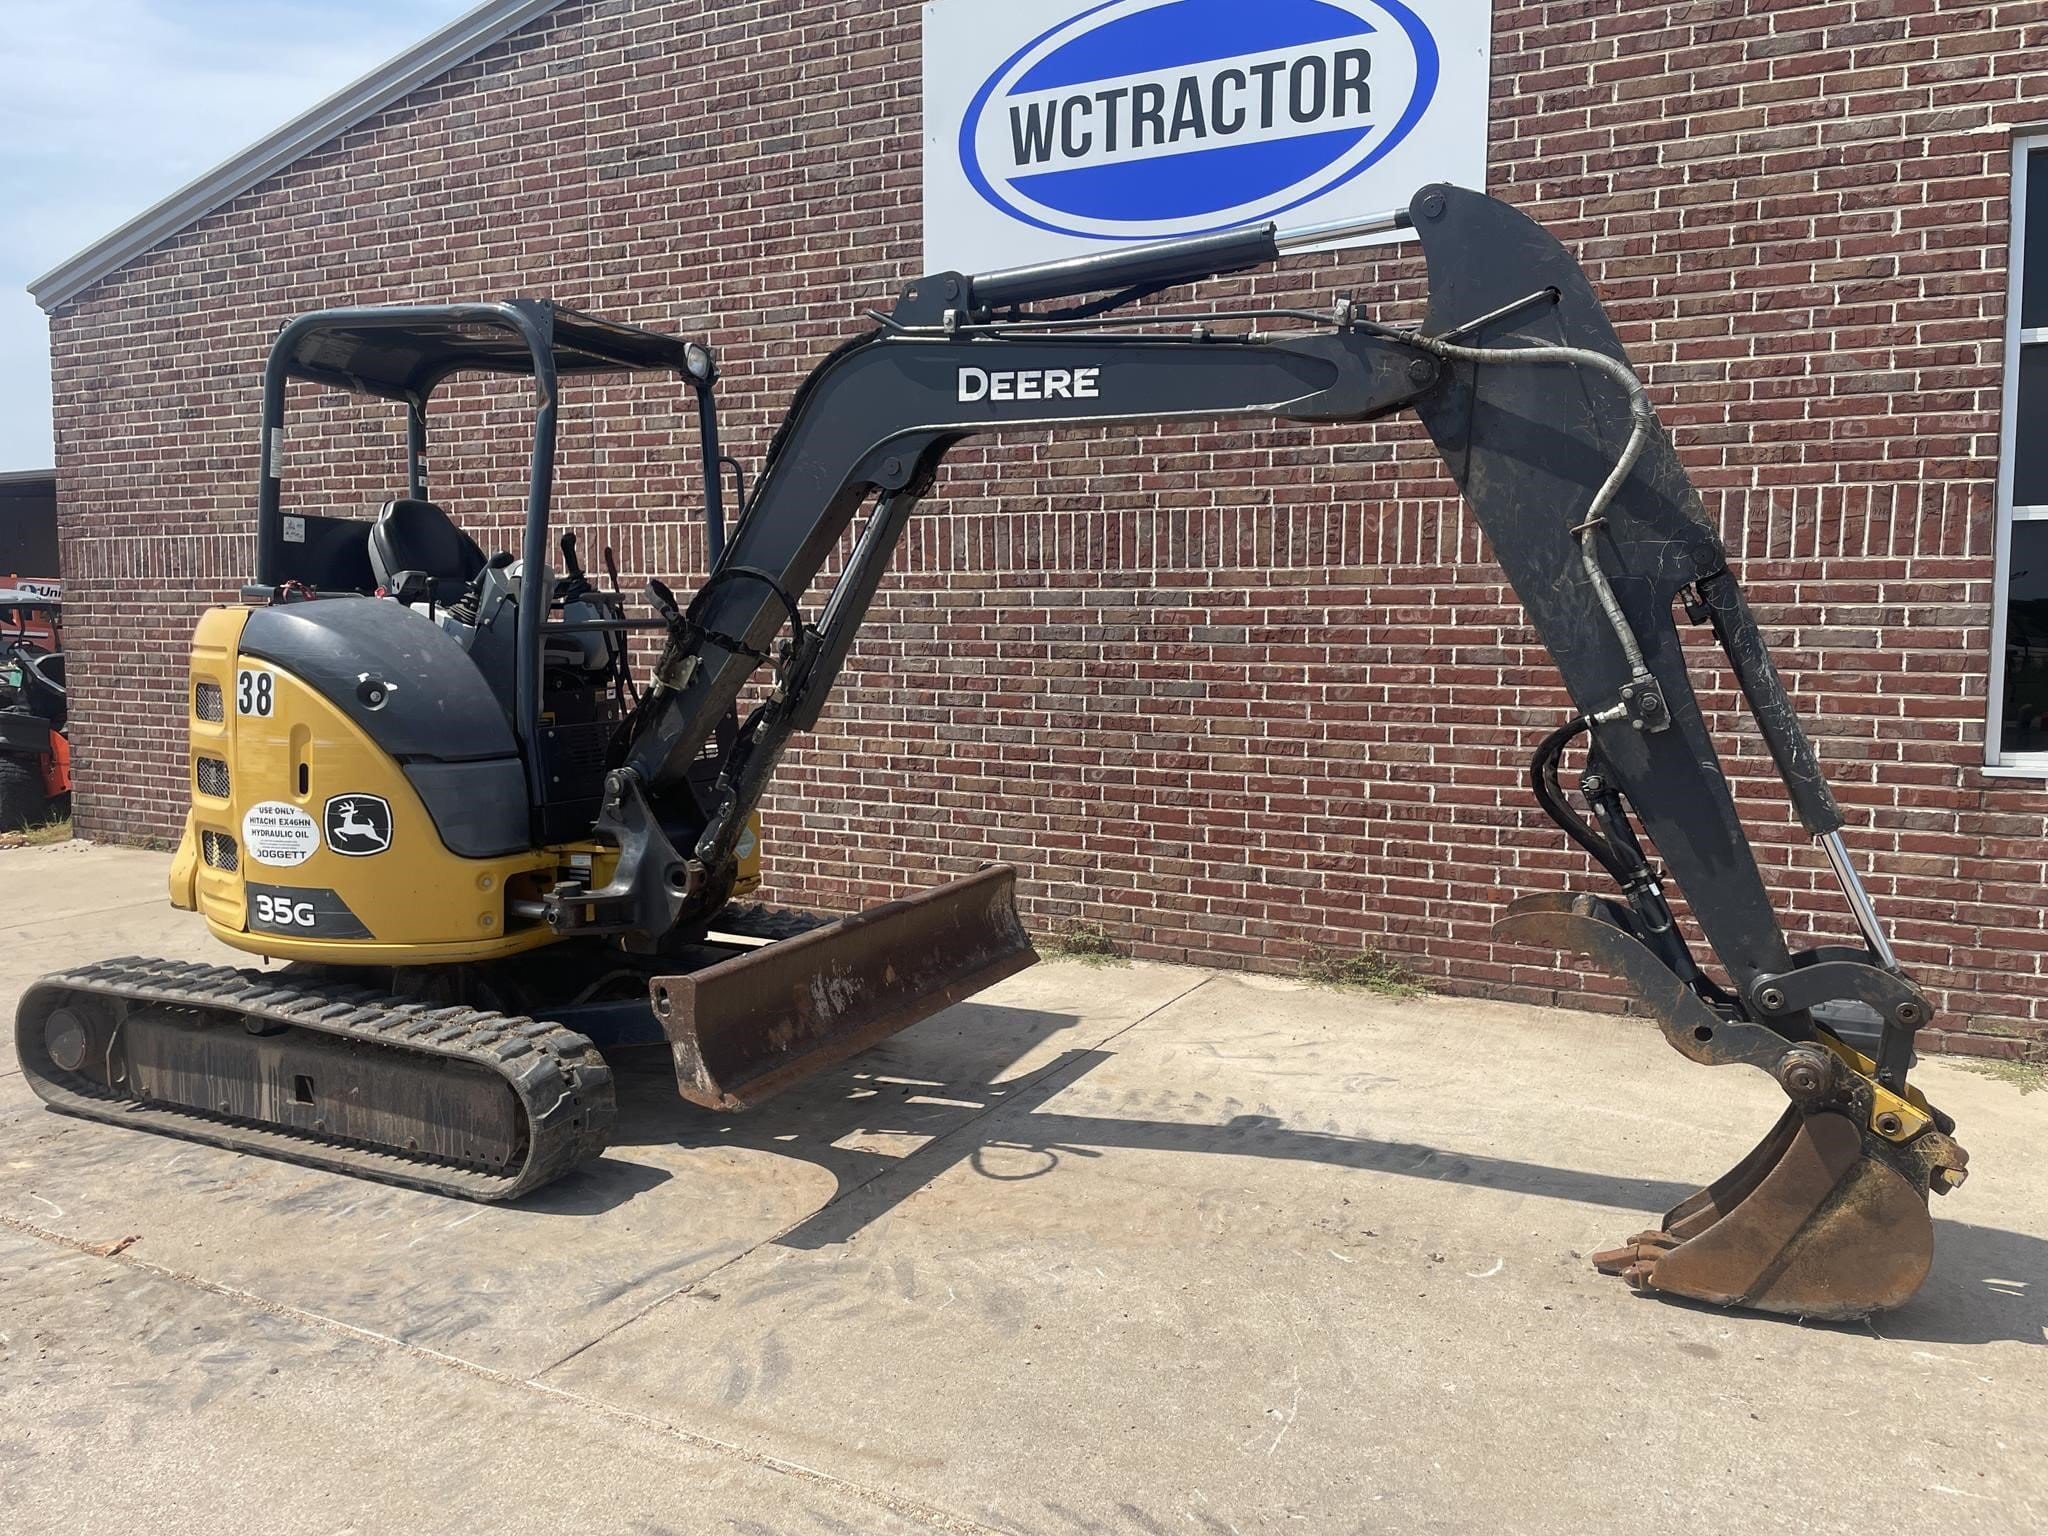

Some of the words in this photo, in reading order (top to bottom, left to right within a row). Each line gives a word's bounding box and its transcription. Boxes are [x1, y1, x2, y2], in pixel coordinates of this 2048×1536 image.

[1008, 48, 1372, 166] WCTRACTOR
[957, 367, 1100, 402] DEERE
[238, 671, 272, 716] 38
[249, 816, 277, 825] HITACHI
[279, 818, 311, 826] EX46HN
[259, 806, 273, 815] USE
[274, 807, 295, 815] ONLY
[251, 829, 293, 838] HYDRAULIC
[295, 830, 309, 839] OIL
[256, 894, 316, 927] 35G
